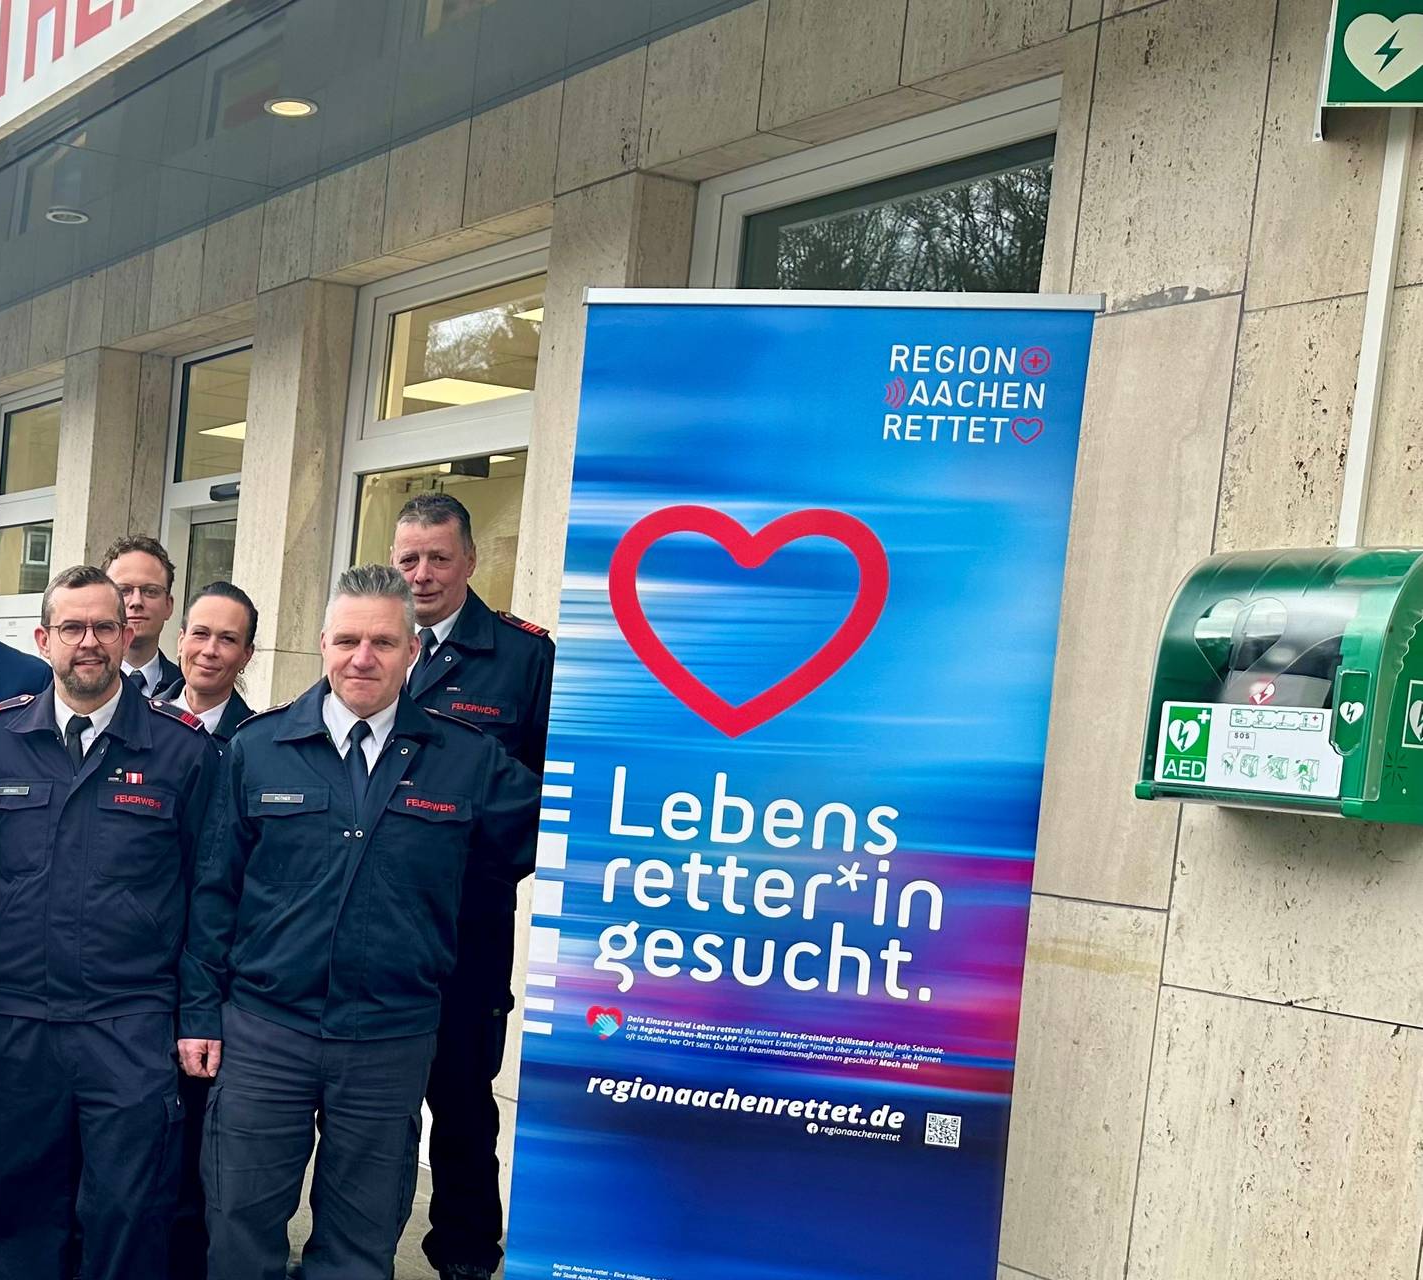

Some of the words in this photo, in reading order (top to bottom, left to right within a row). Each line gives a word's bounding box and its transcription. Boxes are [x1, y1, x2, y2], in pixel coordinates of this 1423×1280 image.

[889, 343, 1017, 376] REGION
[907, 380, 1047, 410] AACHEN
[882, 412, 1010, 446] RETTET
[451, 702, 501, 716] FEUERWEHR
[1163, 760, 1205, 778] AED
[405, 798, 457, 813] FEUERWEHR
[607, 765, 900, 857] Lebens
[592, 920, 933, 1002] gesucht.
[626, 1033, 636, 1041] oft
[637, 1034, 668, 1044] schneller
[683, 1039, 695, 1047] Ort
[696, 1041, 713, 1049] sein.
[843, 1055, 878, 1066] geschult?
[879, 1059, 900, 1068] Mach
[901, 1062, 919, 1070] mit!
[627, 1015, 644, 1023] Dein
[645, 1017, 673, 1027] Einsatz
[674, 1020, 691, 1029] wird
[693, 1023, 716, 1032] Leben
[717, 1025, 743, 1034] retten!
[757, 1029, 779, 1037] einem
[780, 1031, 875, 1047] Herz-Kreislauf-Stillstand
[895, 1044, 911, 1052] jede
[912, 1044, 945, 1055] Sekunde.
[627, 1024, 638, 1032] Die
[639, 1026, 737, 1042] Region-Aachen-Rettet-APP
[738, 1036, 774, 1047] informiert
[836, 1046, 853, 1055] über
[853, 1047, 868, 1056] den
[869, 1050, 895, 1060] Notfall
[913, 1054, 942, 1063] können
[585, 1072, 907, 1131] regionaachenrettet.de
[819, 1123, 902, 1143] regionaachenrettet
